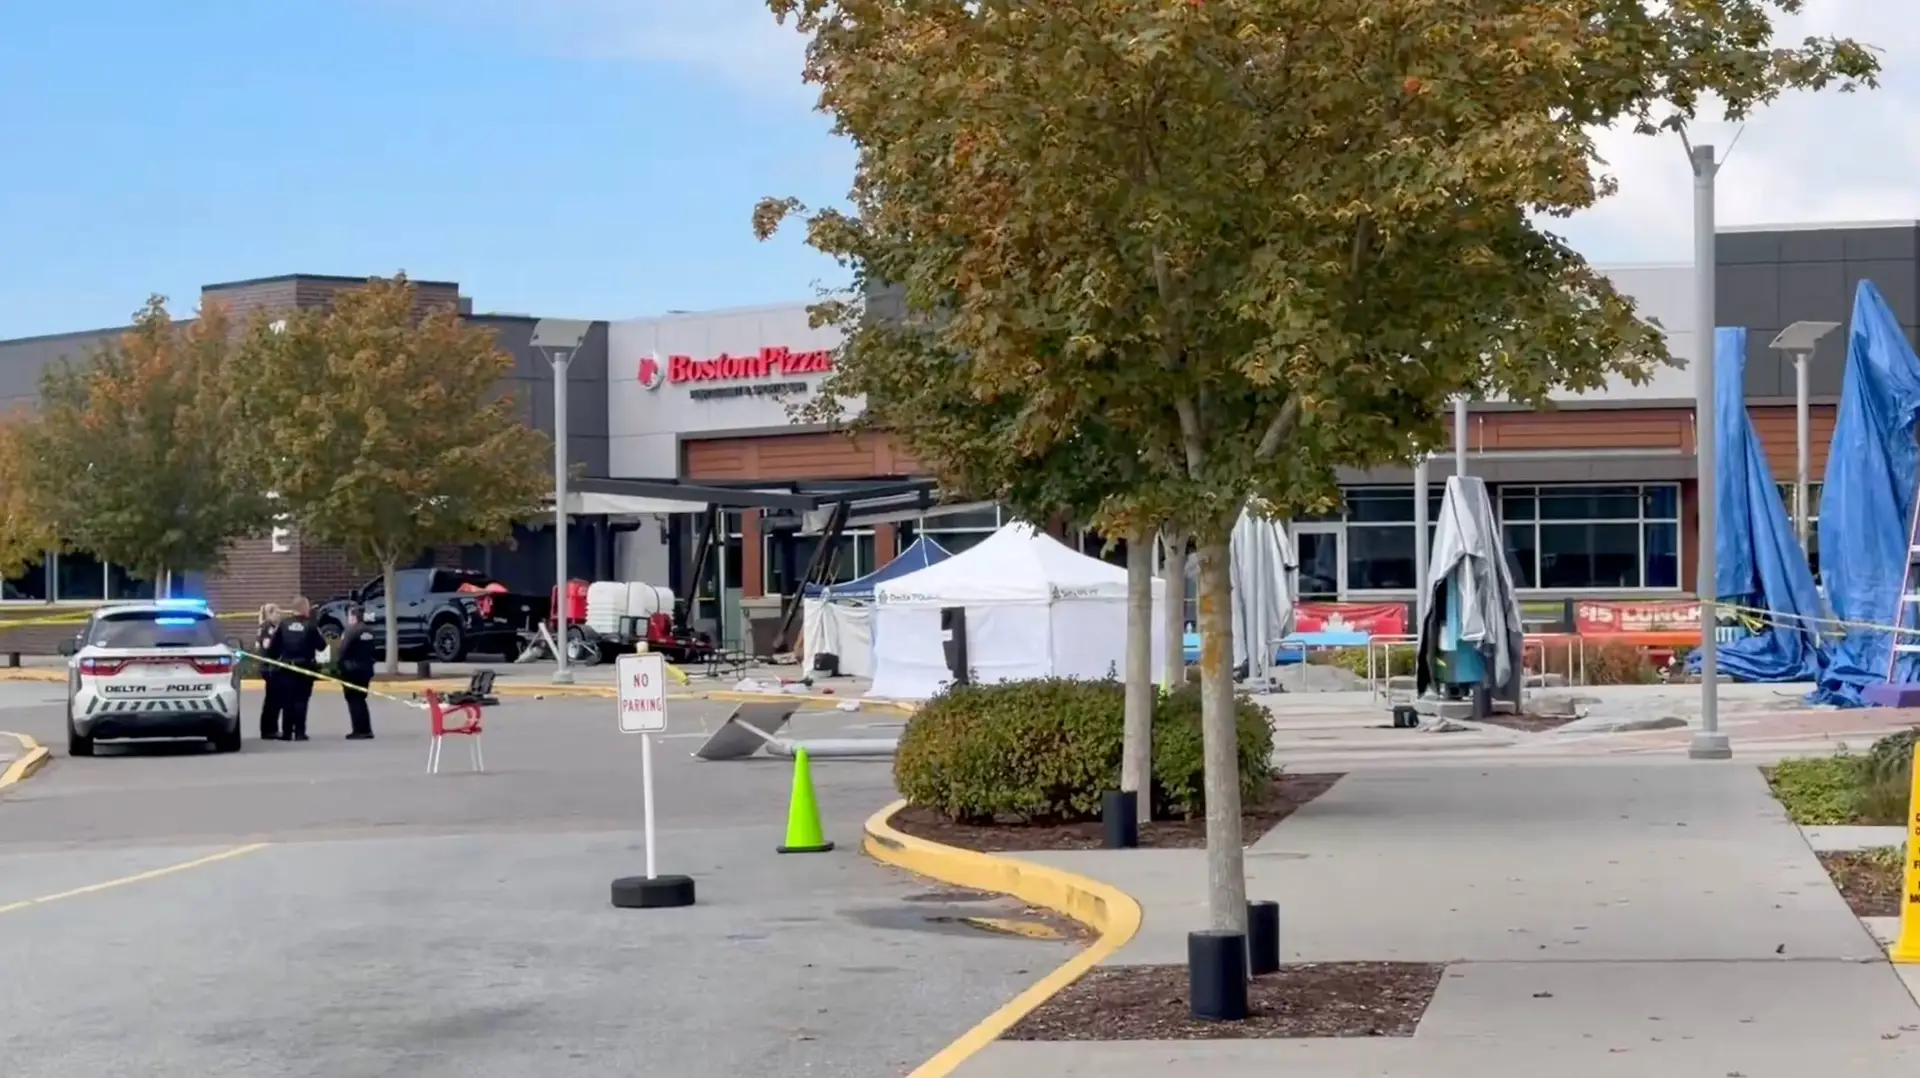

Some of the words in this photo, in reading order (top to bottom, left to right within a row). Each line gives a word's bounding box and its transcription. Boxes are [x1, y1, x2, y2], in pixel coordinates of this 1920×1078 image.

[1621, 606, 1702, 622] LUNCH
[633, 672, 649, 688] NO
[105, 685, 147, 693] DELTA
[166, 683, 213, 692] POLICE
[623, 697, 662, 712] PARKING
